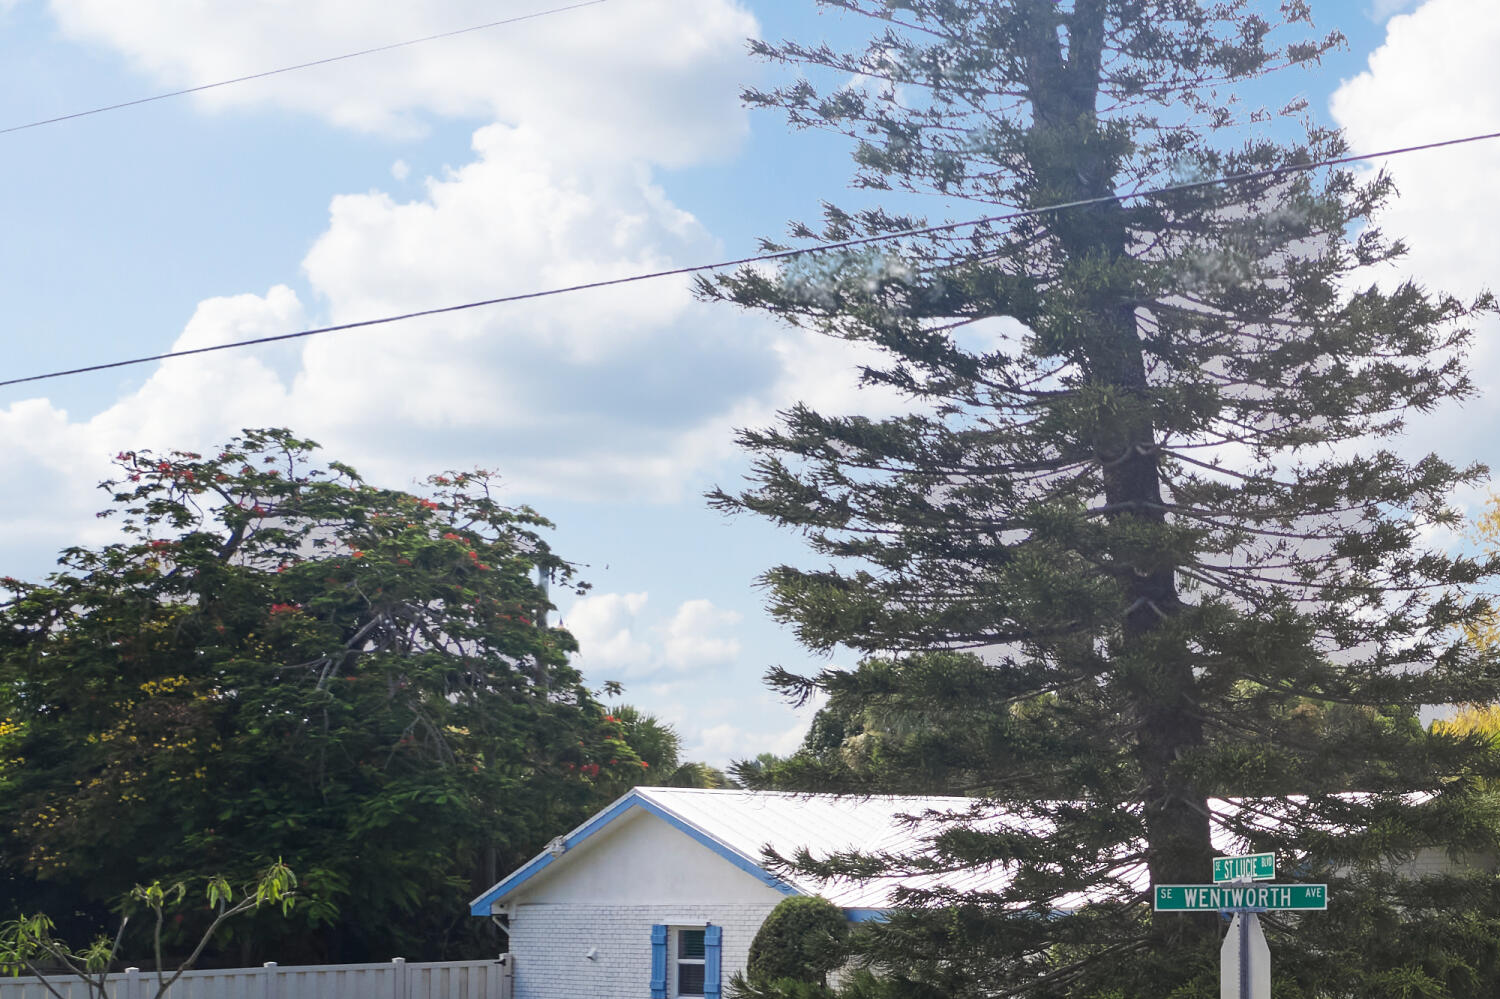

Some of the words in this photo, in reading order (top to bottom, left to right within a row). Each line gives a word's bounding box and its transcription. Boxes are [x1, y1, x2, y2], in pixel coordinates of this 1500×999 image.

[1215, 861, 1221, 871] SE
[1224, 862, 1233, 879] ST
[1235, 856, 1258, 878] LUCIE
[1261, 858, 1273, 868] BLVD
[1160, 888, 1173, 899] SE
[1184, 888, 1291, 908] WENTWORTH
[1305, 888, 1322, 898] AVE
